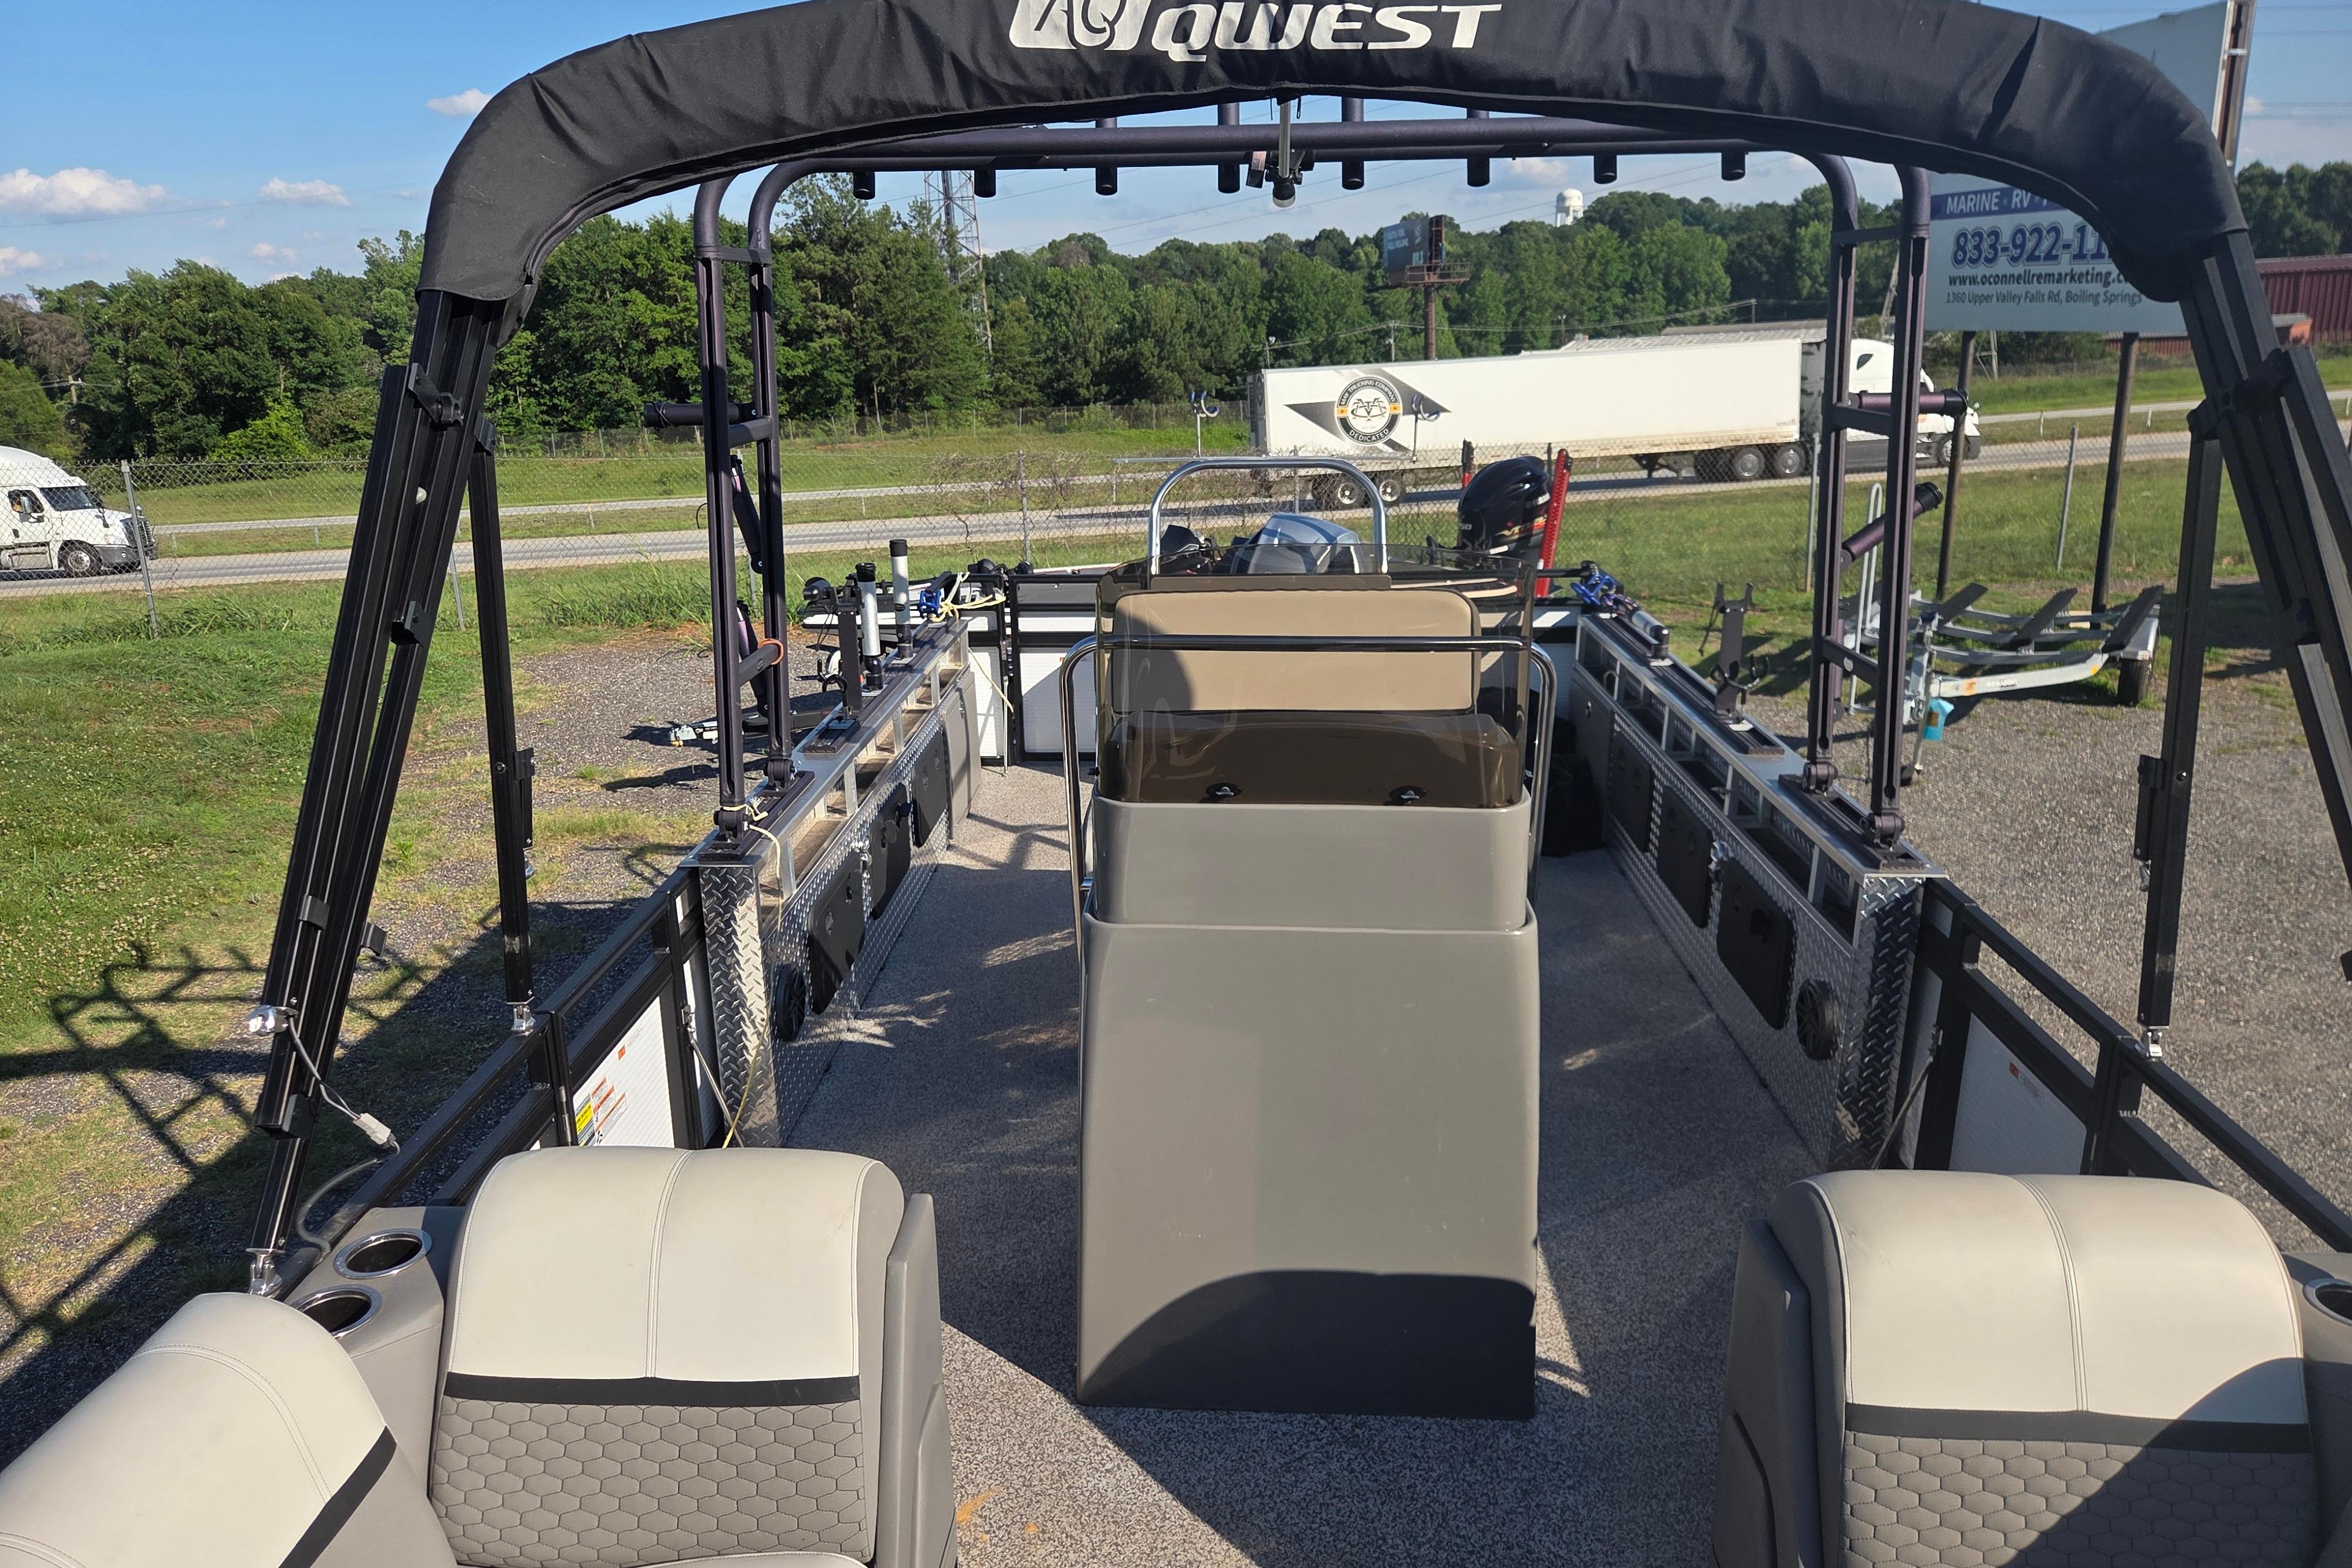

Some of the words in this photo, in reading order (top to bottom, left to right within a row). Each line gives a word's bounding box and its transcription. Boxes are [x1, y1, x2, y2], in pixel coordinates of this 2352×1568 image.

[1152, 2, 1502, 62] QWEST
[1946, 191, 2001, 214] MARINE
[2012, 189, 2032, 209] RV
[1952, 222, 2112, 269] 833-922-11
[1949, 267, 2129, 287] www.oconnellremarketing.c
[1967, 291, 1994, 305] Upper
[1995, 290, 2023, 306] Valley
[2024, 290, 2046, 303] Falls
[2047, 290, 2063, 305] Rd,
[2065, 289, 2101, 306] Boiling
[2103, 289, 2143, 307] Springs
[1341, 392, 1349, 405] MAY
[1348, 380, 1374, 393] TRUCKING
[1375, 382, 1396, 402] COMPANY
[1349, 429, 1389, 442] DEDICATED
